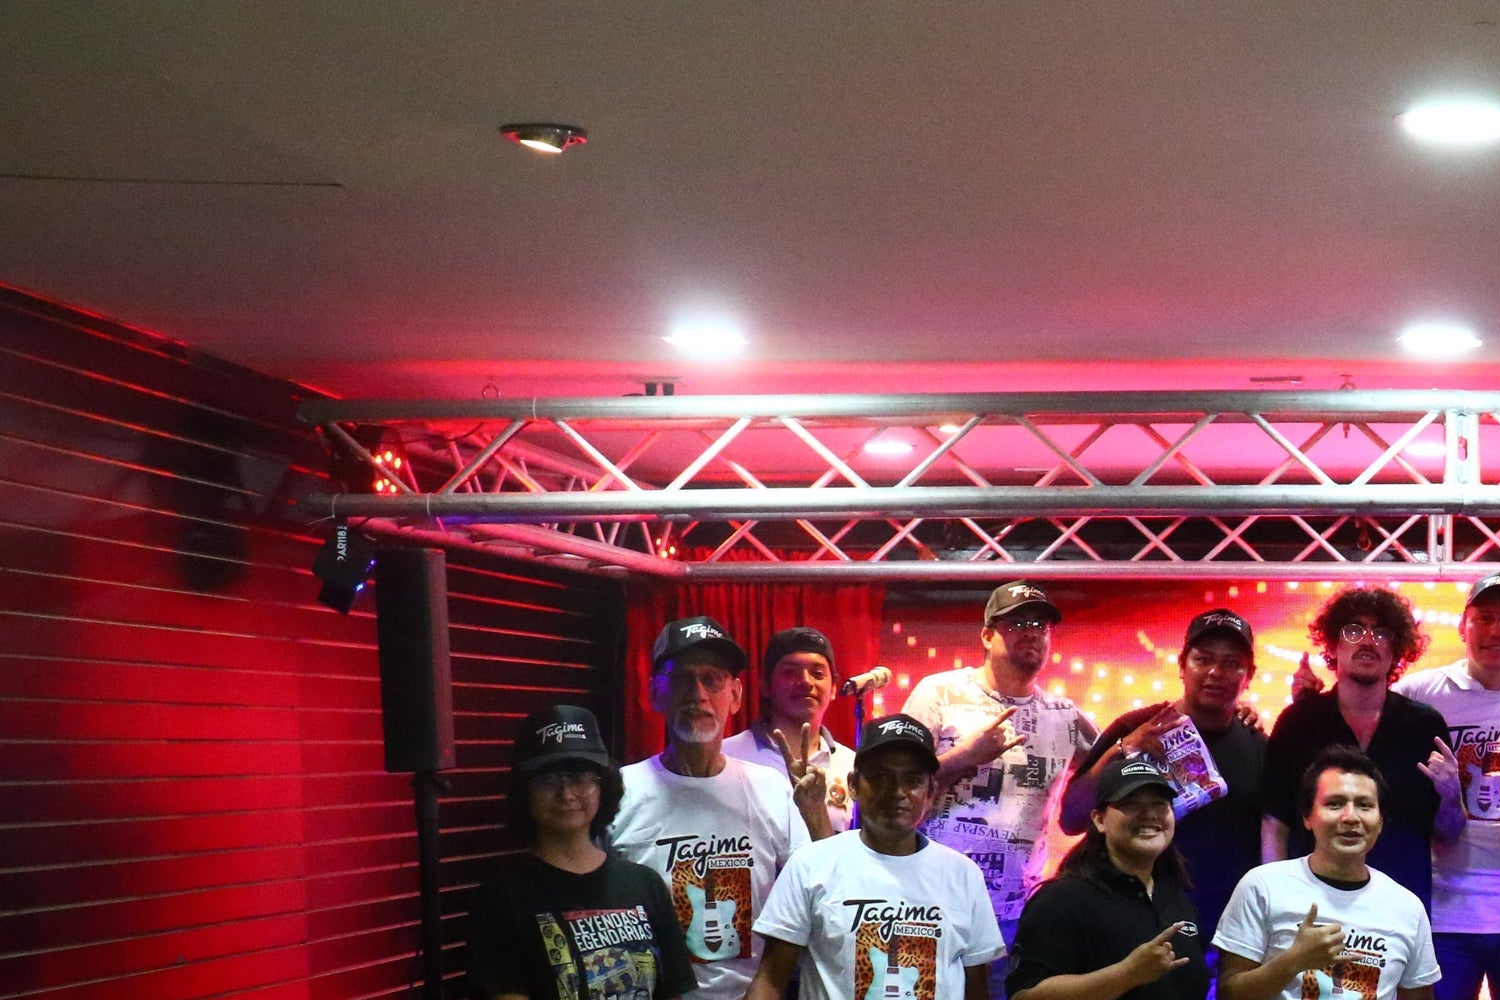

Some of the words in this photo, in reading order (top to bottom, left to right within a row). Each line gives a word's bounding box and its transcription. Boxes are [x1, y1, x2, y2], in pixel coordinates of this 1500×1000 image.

[536, 721, 586, 745] Tagima
[878, 719, 925, 737] Tagima
[655, 834, 753, 877] Tagima
[709, 859, 747, 868] MEXICO
[569, 909, 640, 936] LEYENDAS
[842, 899, 943, 941] Tagima
[895, 925, 935, 936] MEXICO
